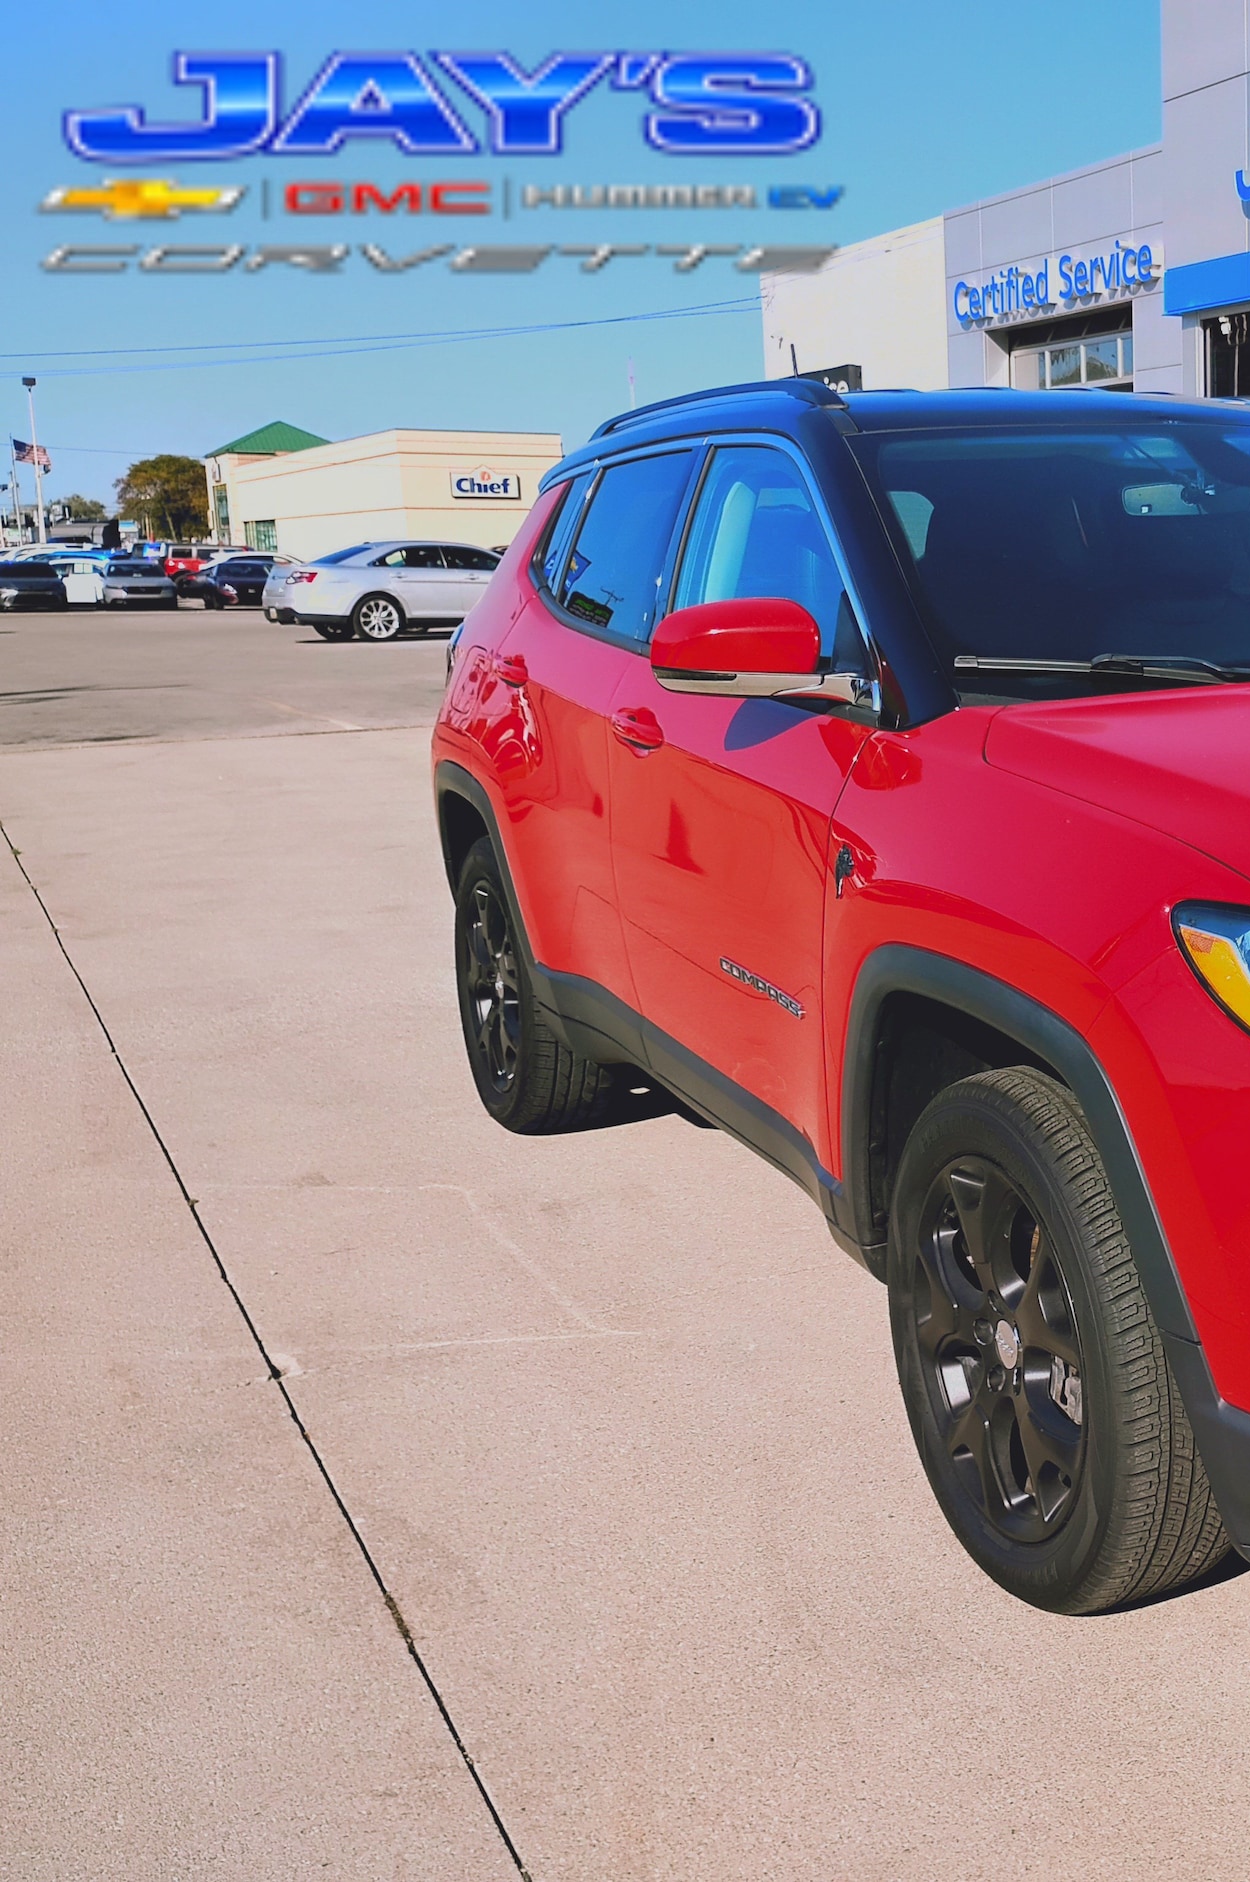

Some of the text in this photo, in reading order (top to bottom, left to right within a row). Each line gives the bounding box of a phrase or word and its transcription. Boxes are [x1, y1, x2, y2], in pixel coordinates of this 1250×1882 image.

[954, 240, 1153, 323] Certified Service
[456, 477, 510, 494] Chief
[719, 957, 803, 1020] COMPASS
